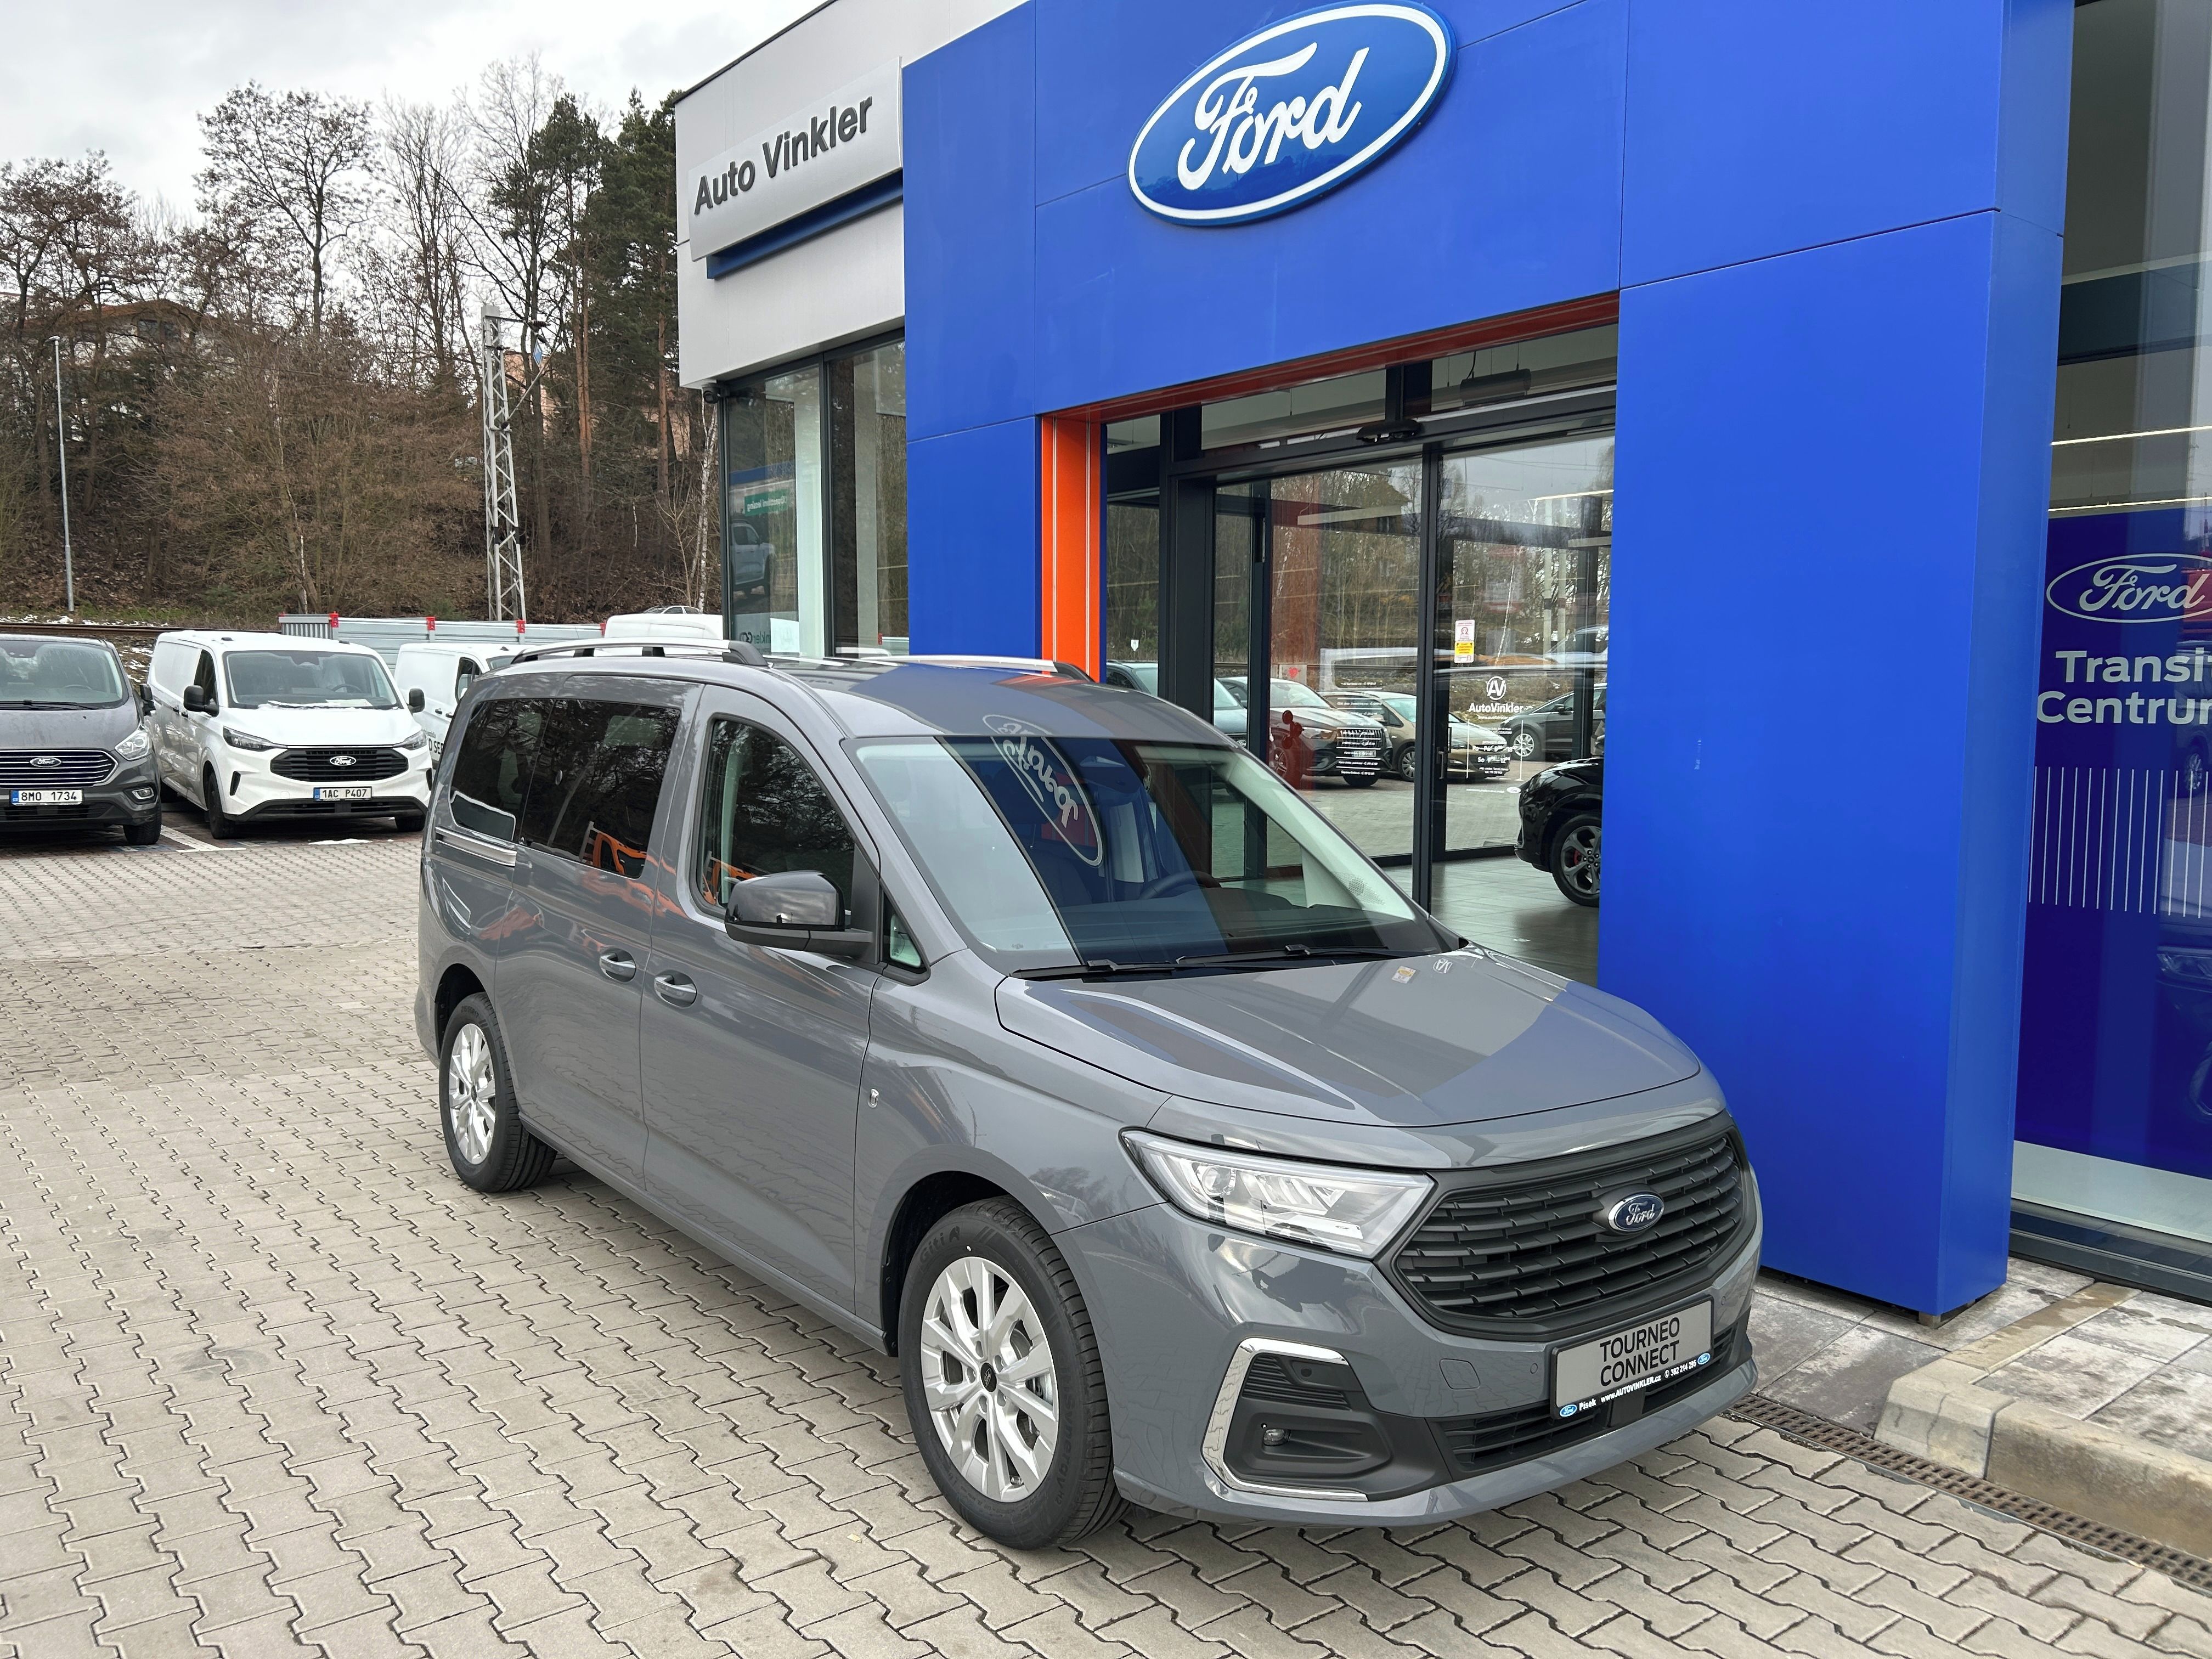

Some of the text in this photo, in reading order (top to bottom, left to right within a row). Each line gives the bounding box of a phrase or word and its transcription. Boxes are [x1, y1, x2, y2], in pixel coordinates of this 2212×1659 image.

[1177, 42, 1369, 190] Ford
[693, 96, 872, 215] Auto Vinkler
[2079, 564, 2209, 611] Ford
[2056, 647, 2212, 682] Transi
[1469, 702, 1523, 713] AutoVinkler
[51, 792, 77, 800] 1734
[323, 789, 367, 798] 1AC P407
[1626, 1201, 1655, 1226] Ford
[1600, 1317, 1680, 1362] TOURNEO
[1600, 1340, 1680, 1387] CONNECT
[1579, 1398, 1596, 1411] Písek
[1600, 1374, 1662, 1403] www.AUTOVINKLER.cz
